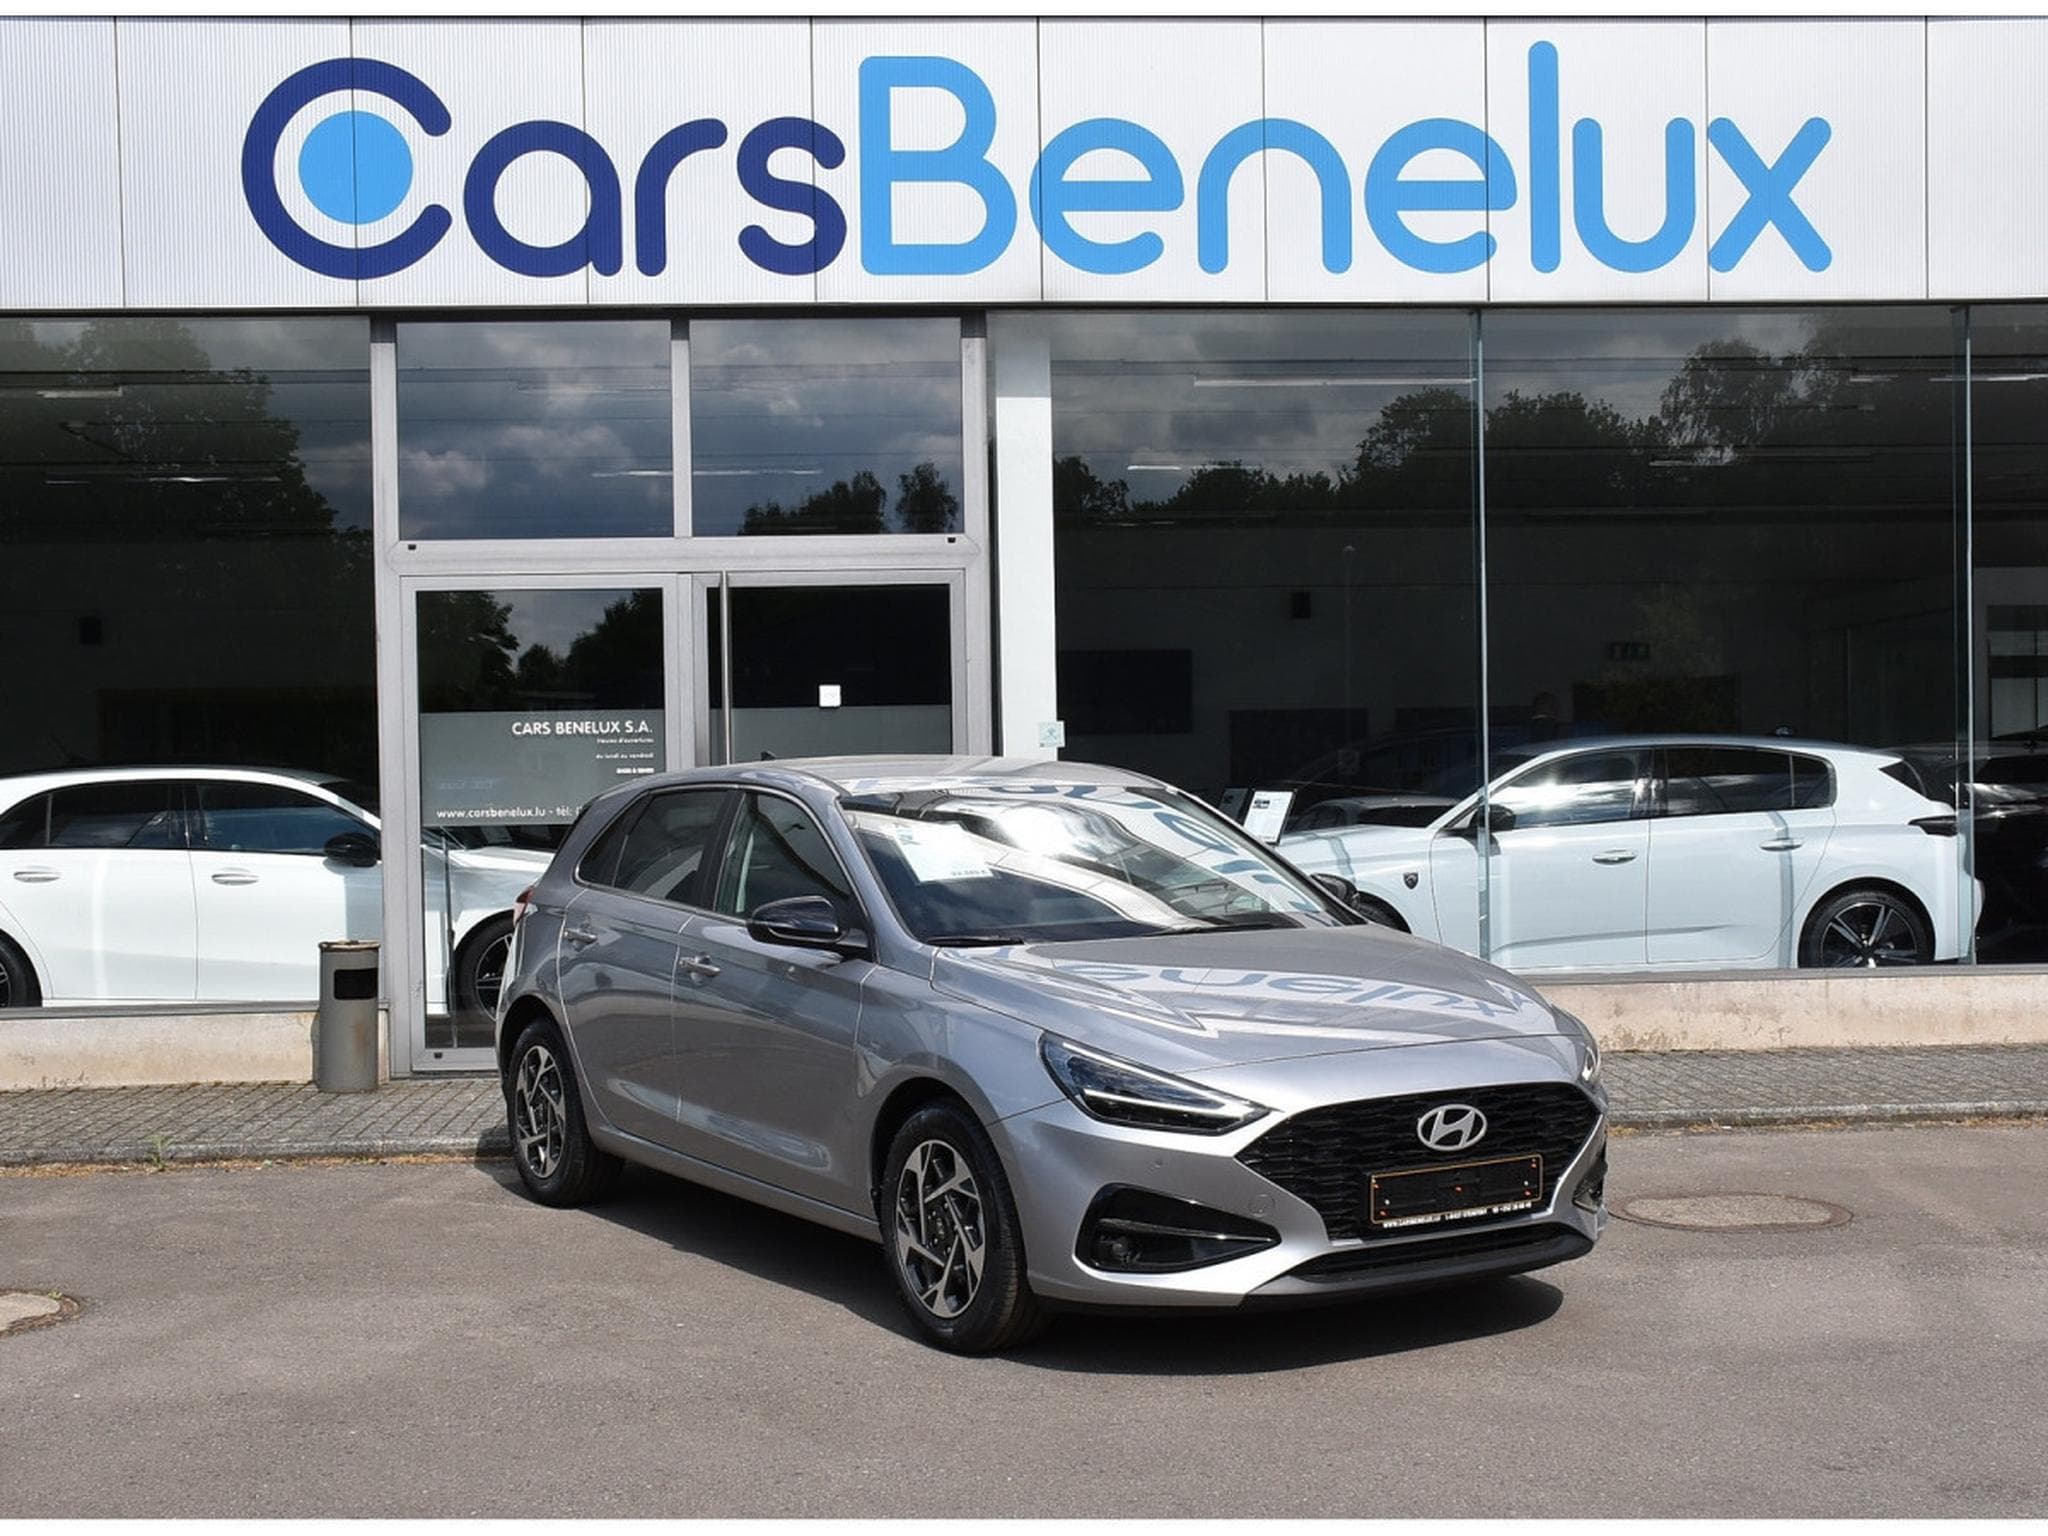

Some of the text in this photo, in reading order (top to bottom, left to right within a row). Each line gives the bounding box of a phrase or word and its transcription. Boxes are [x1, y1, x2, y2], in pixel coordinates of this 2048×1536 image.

[511, 720, 653, 735] CARS BENELUX S.A.
